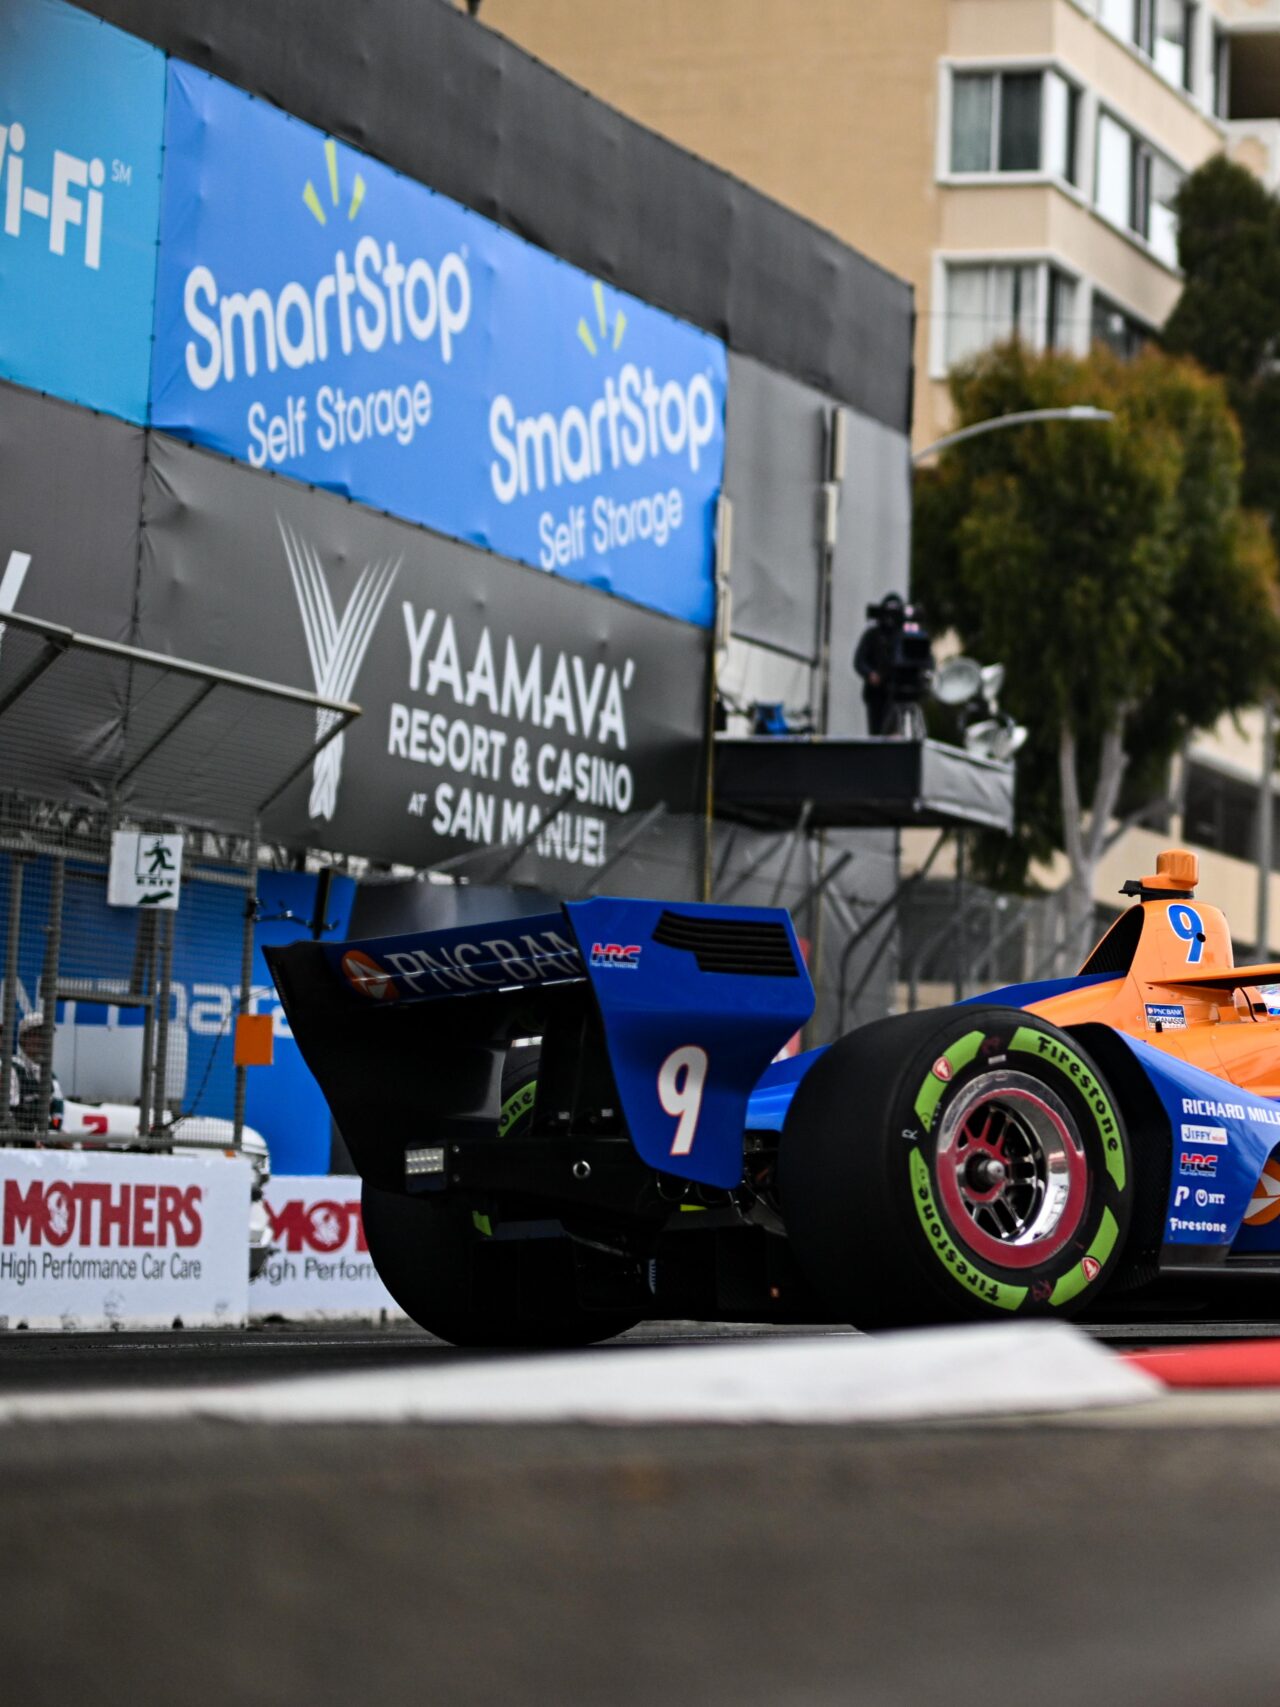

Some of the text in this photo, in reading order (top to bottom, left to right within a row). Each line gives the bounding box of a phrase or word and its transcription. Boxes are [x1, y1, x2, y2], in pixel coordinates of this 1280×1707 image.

[184, 236, 470, 390] SmartStop
[247, 379, 432, 468] Self Storage
[489, 363, 714, 503] SmartStop
[538, 487, 684, 571] Self Storage
[388, 703, 633, 814] RESORT & CASINO
[407, 792, 427, 817] AT
[432, 783, 496, 845] SAN
[590, 942, 642, 963] HRC
[1167, 903, 1205, 964] 9
[656, 1044, 708, 1156] 9
[1036, 1034, 1119, 1152] Firestone
[1182, 1098, 1246, 1120] RICHARD
[1180, 1152, 1218, 1173] HRC
[3, 1180, 202, 1248] MOTHERS
[917, 1185, 1001, 1302] Firestone
[1169, 1217, 1227, 1233] Firestone
[0, 1252, 202, 1286] High Performance Car Care
